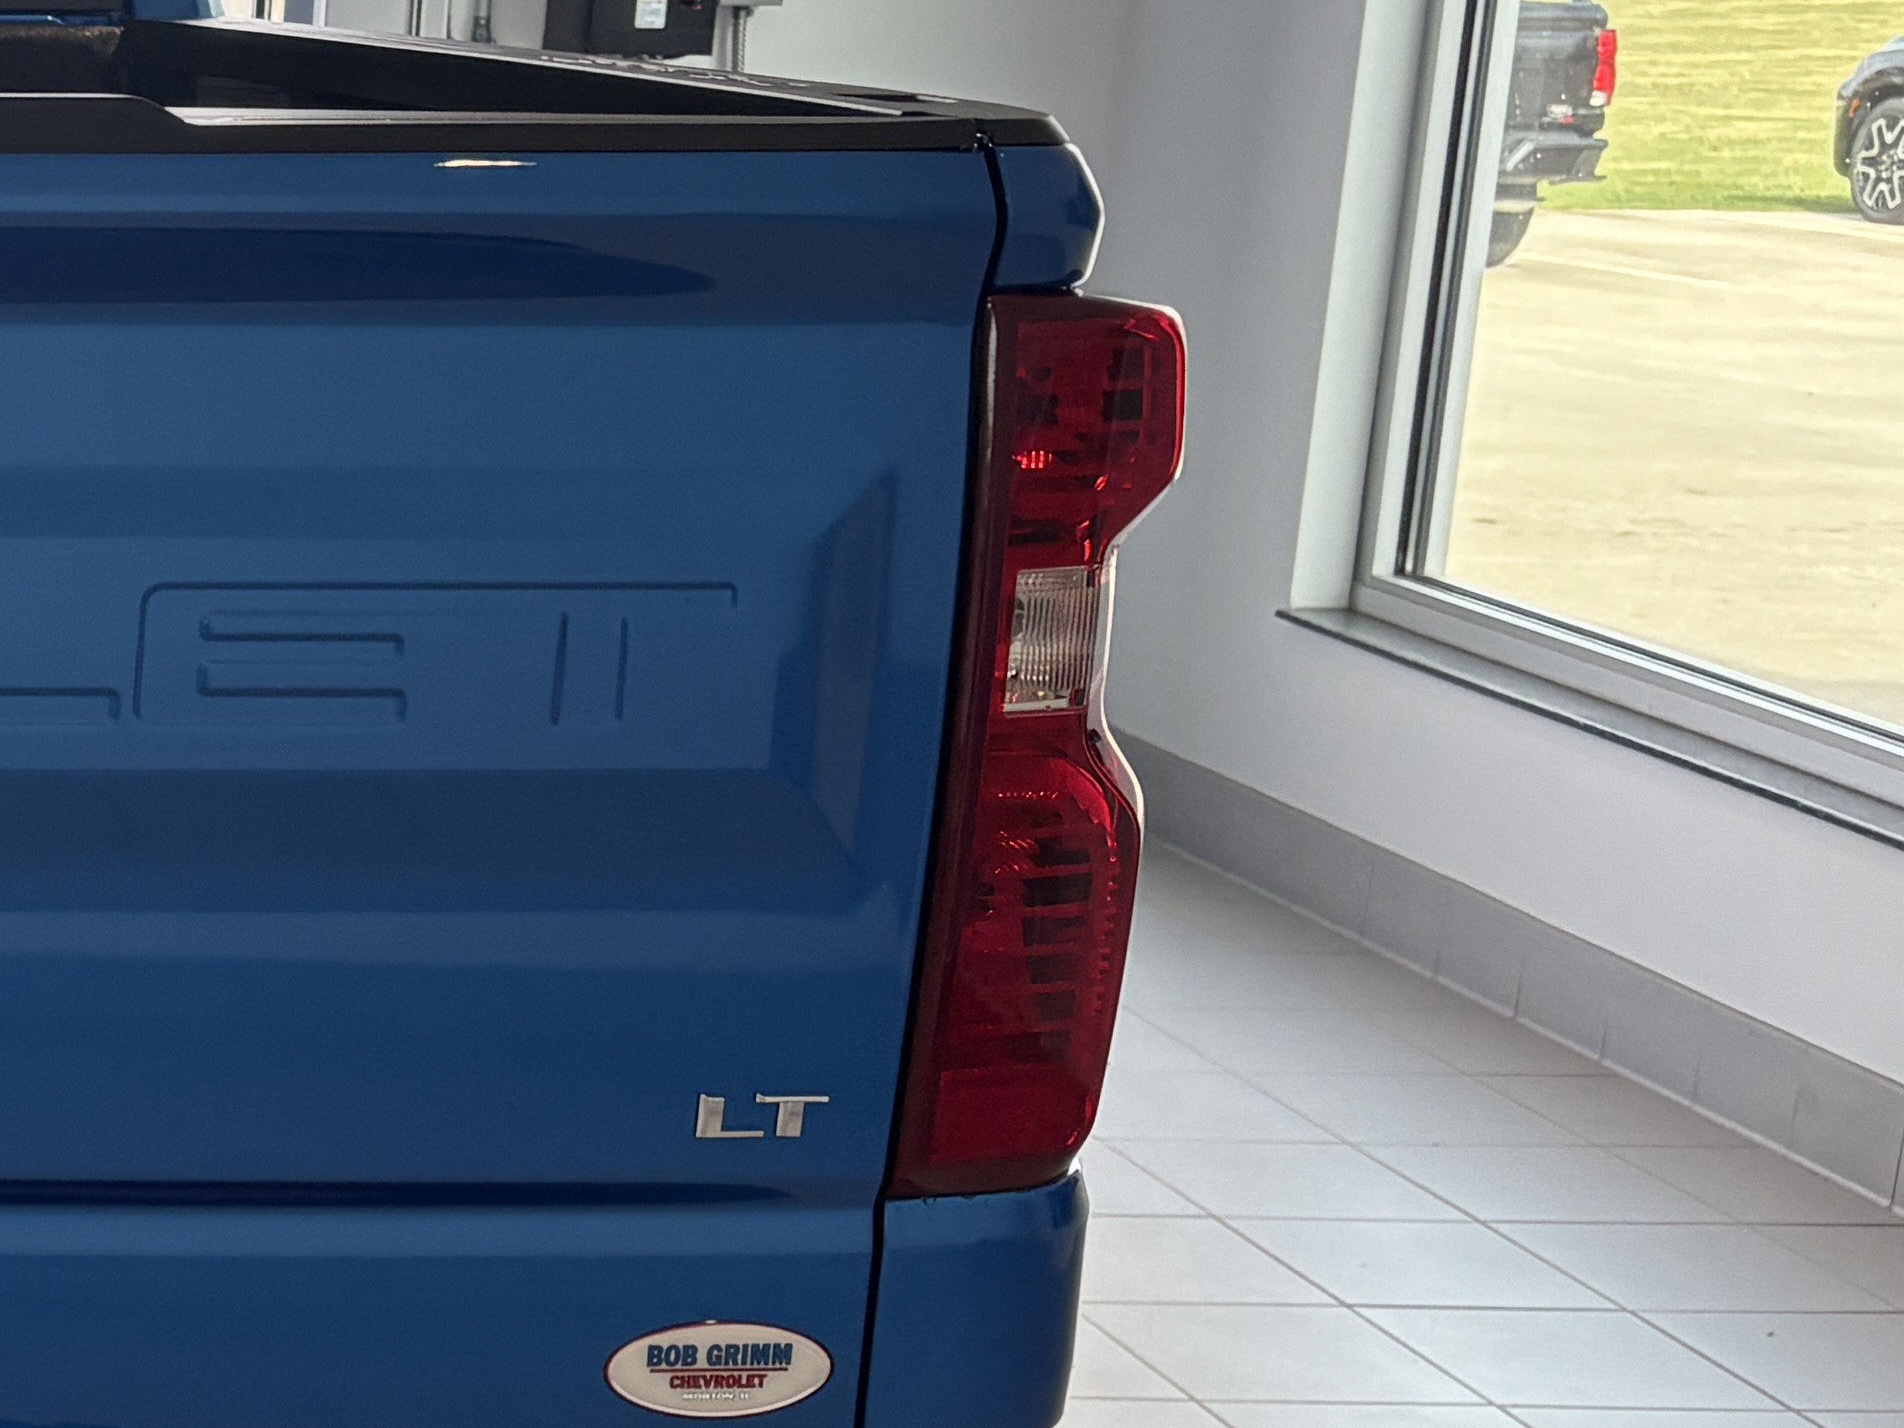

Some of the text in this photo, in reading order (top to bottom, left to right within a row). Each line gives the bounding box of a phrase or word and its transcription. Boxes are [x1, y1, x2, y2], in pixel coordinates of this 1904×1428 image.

[695, 1093, 830, 1139] LT
[646, 1342, 794, 1368] BOB GRIMM
[669, 1373, 769, 1390] CHEVROLET
